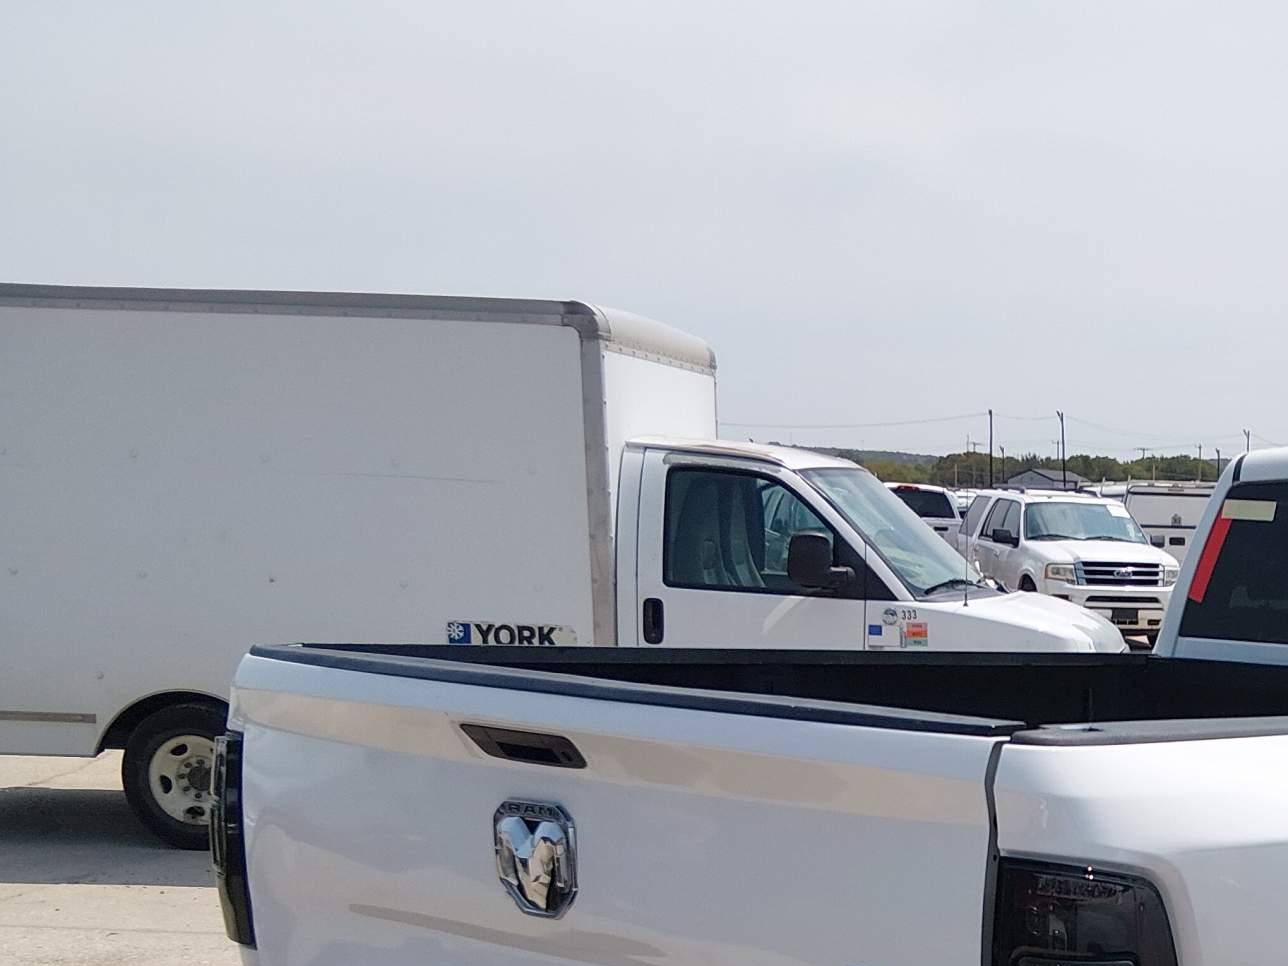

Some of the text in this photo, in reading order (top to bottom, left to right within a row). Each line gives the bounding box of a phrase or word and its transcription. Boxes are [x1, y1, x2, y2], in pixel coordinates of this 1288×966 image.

[902, 609, 917, 620] 333
[474, 623, 557, 646] YORK
[508, 803, 554, 817] RAM
